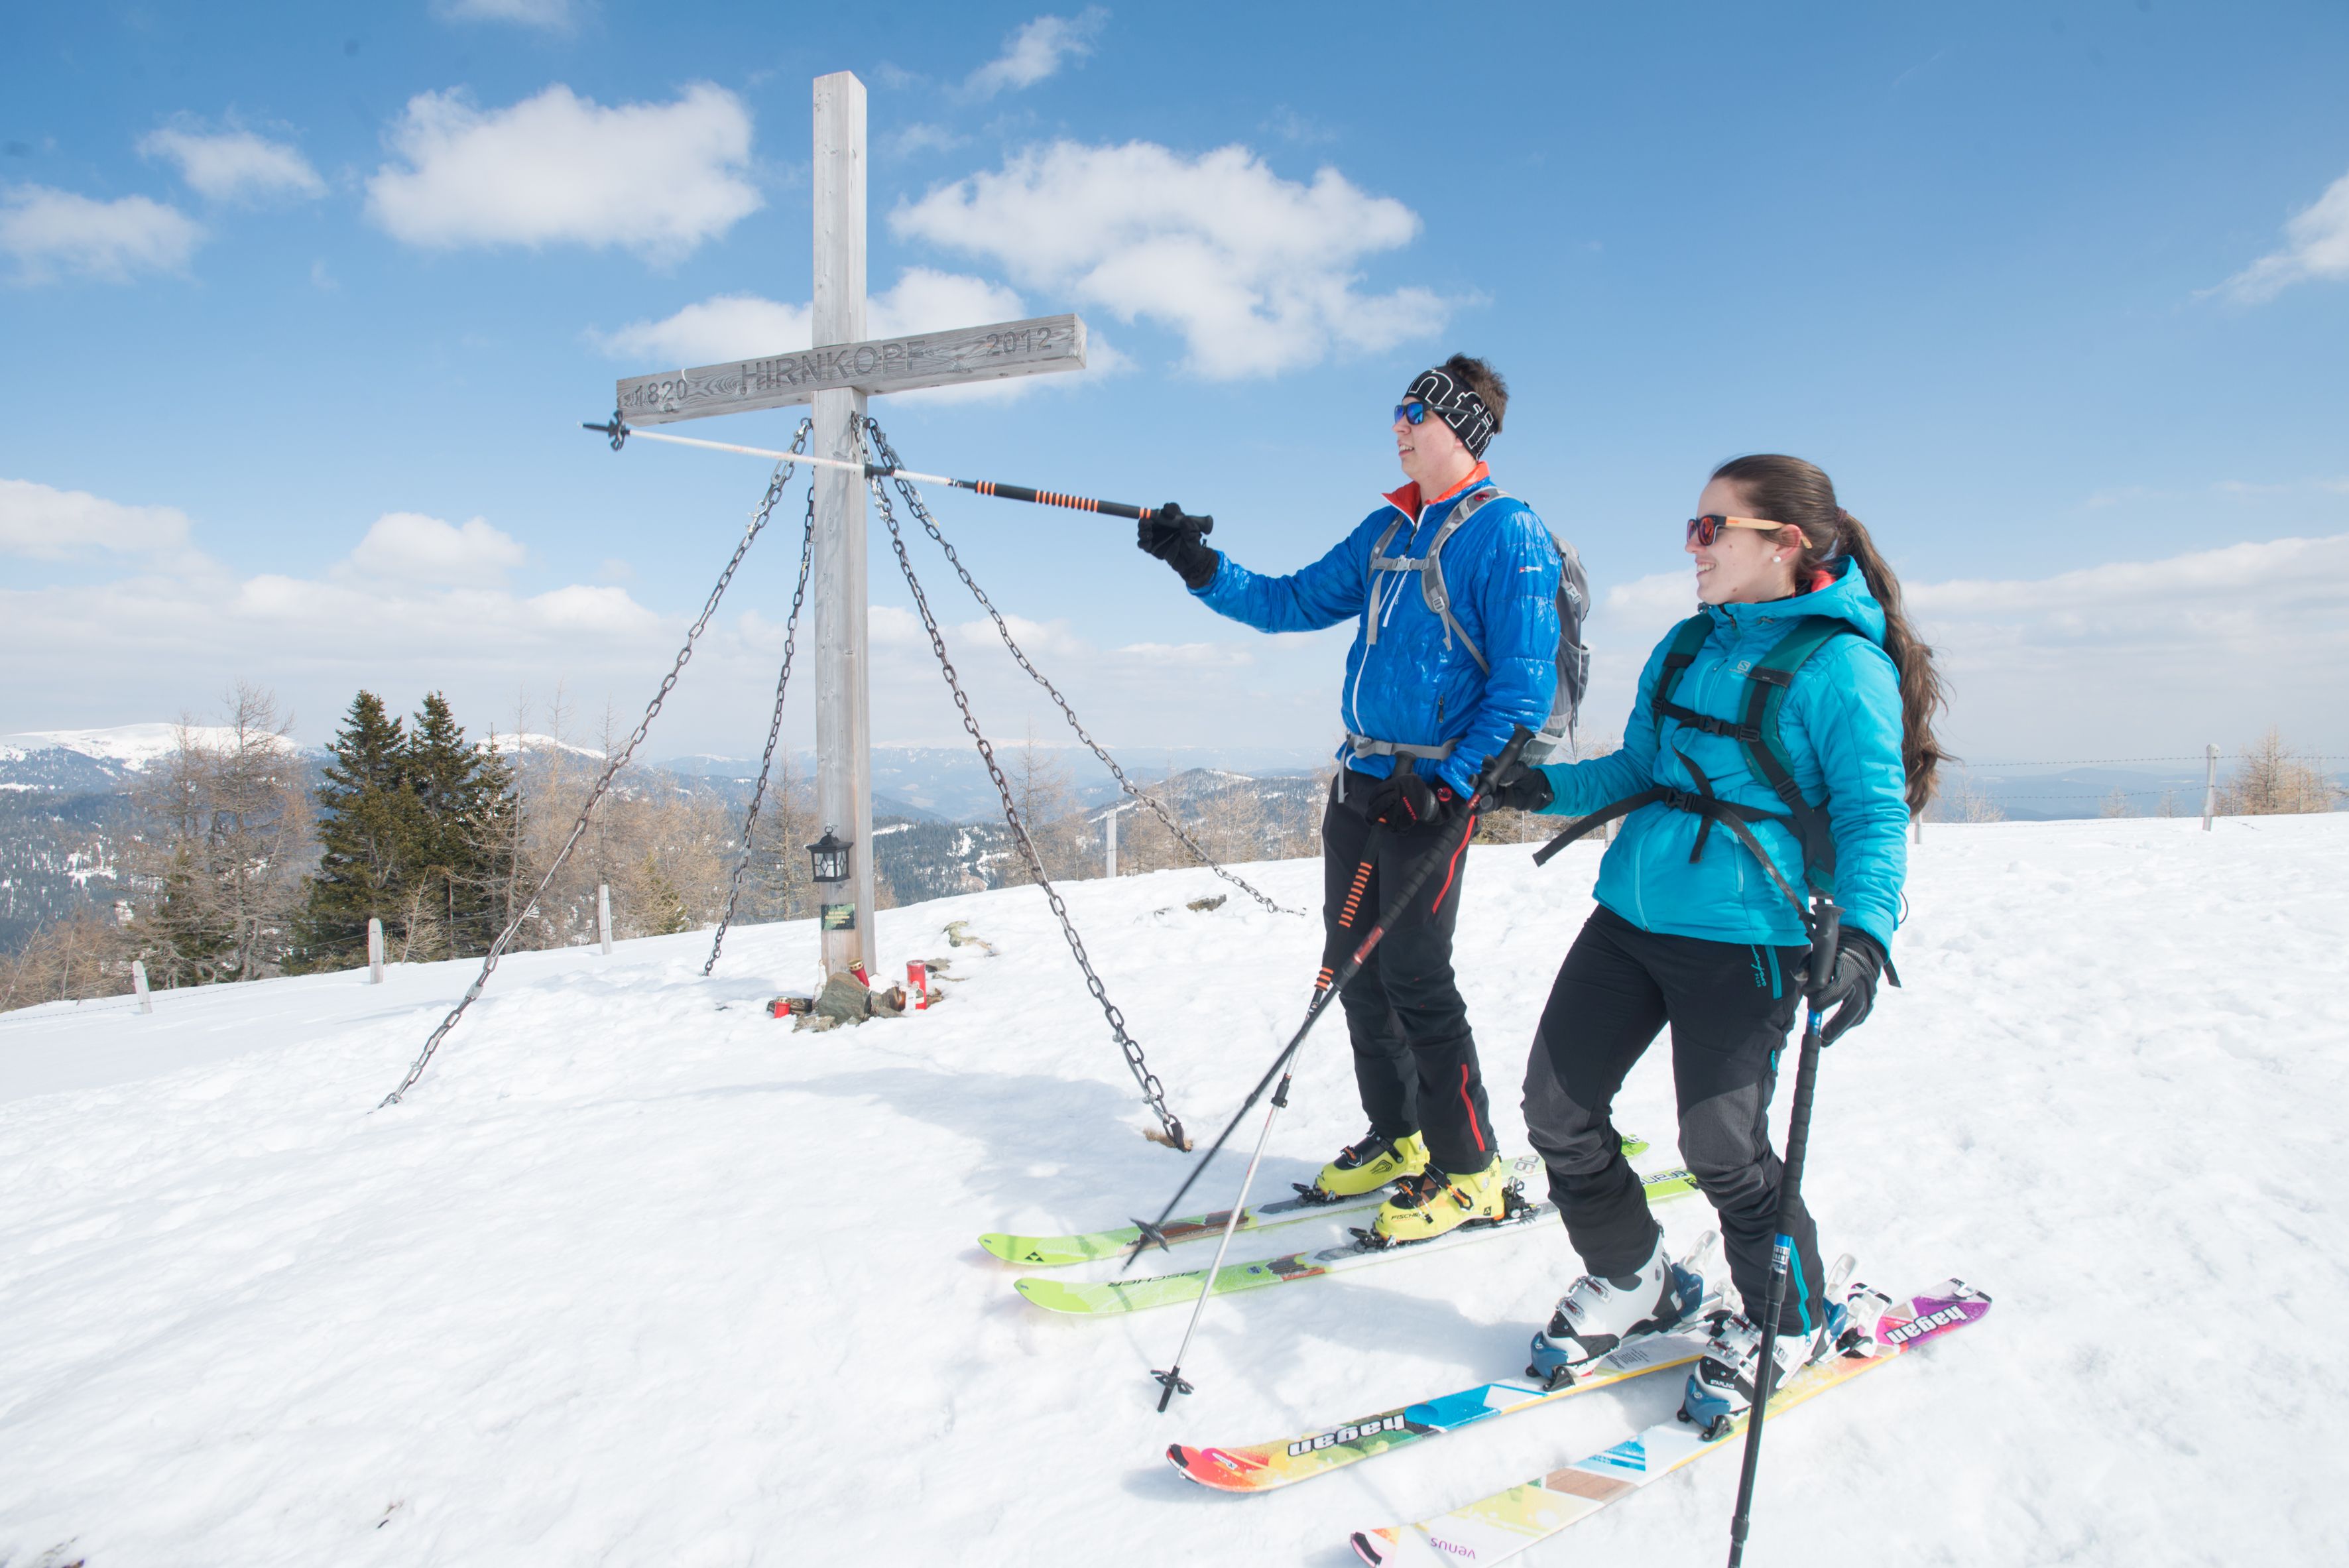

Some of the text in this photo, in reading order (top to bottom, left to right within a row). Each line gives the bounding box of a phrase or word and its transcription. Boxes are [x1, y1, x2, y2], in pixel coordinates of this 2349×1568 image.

[635, 328, 1052, 406] 1820 HIRNKOPF 2012
[1107, 1270, 1199, 1287] FISCHER
[1885, 1304, 1968, 1345] hagan
[1288, 1414, 1405, 1457] hagan
[1431, 1538, 1475, 1559] venus
